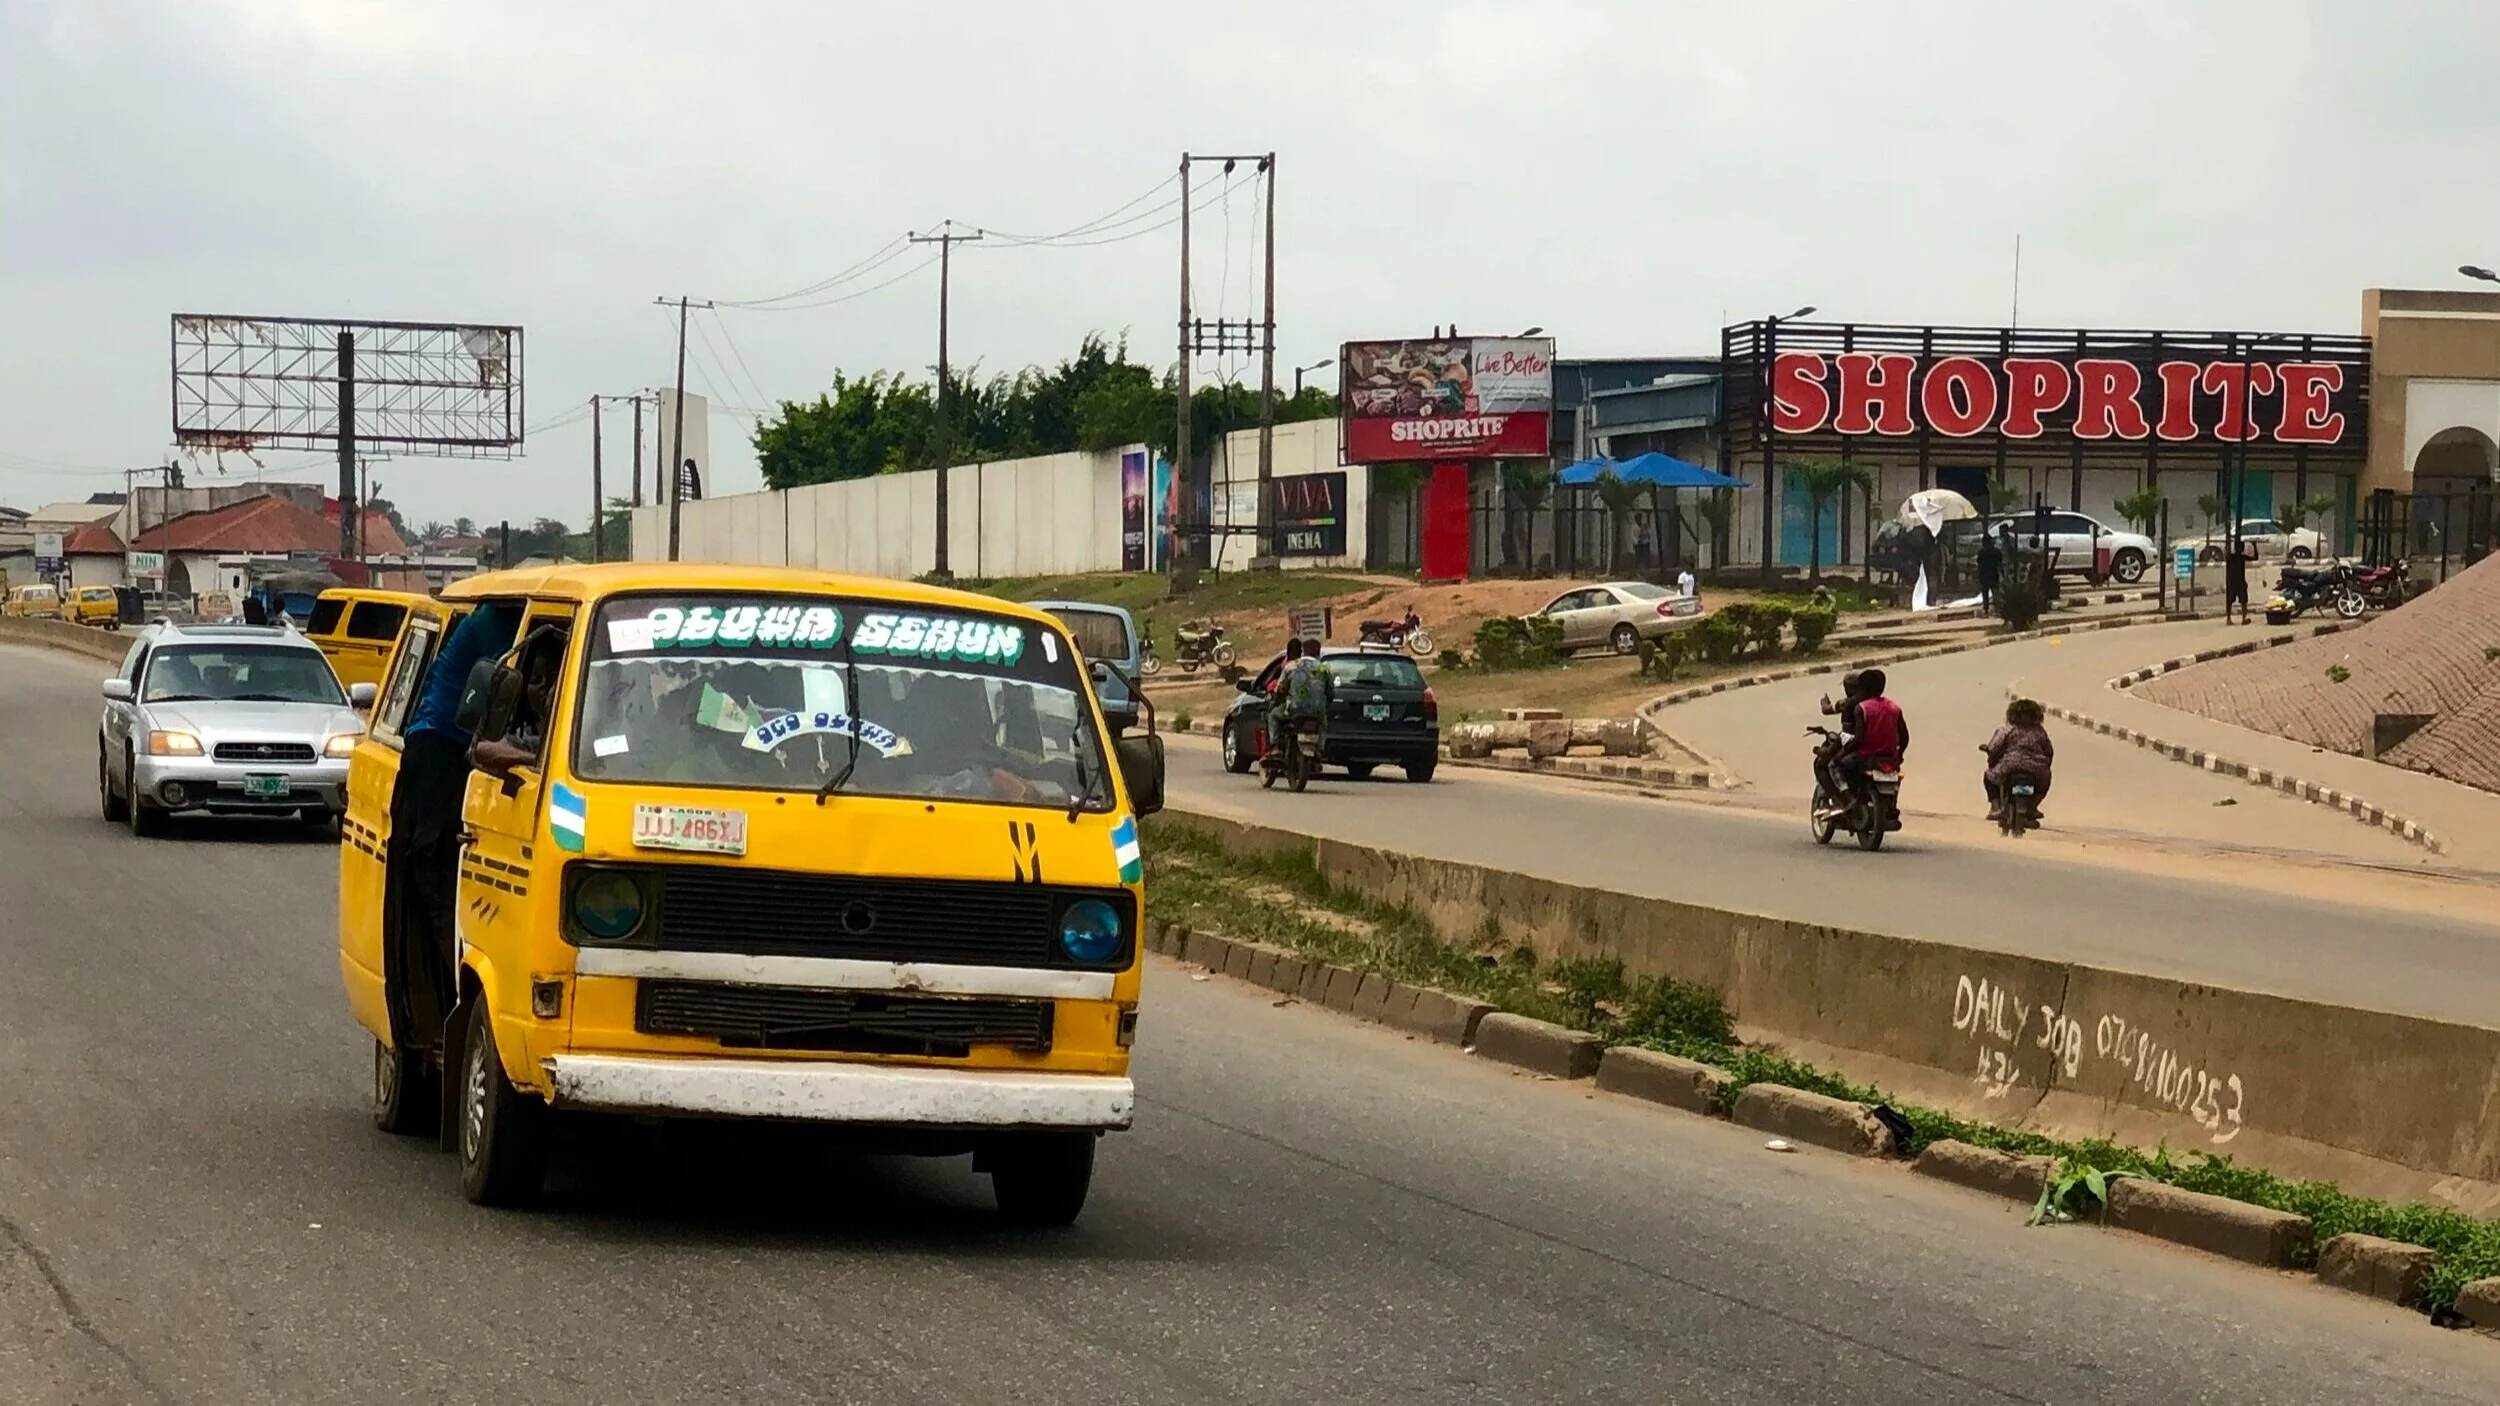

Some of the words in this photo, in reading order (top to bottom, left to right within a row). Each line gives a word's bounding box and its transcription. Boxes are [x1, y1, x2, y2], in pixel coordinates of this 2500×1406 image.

[1475, 351, 1501, 375] Live
[1503, 351, 1548, 376] Better
[1766, 352, 2344, 443] SHOPRITE
[1391, 416, 1505, 441] SHOPRITE
[1278, 479, 1333, 511] VIVA
[135, 554, 157, 568] NIN
[647, 606, 843, 649] OLUWA
[669, 807, 712, 816] LAGOS
[1953, 974, 2029, 1048] DAILY
[2036, 1005, 2081, 1078] JOB
